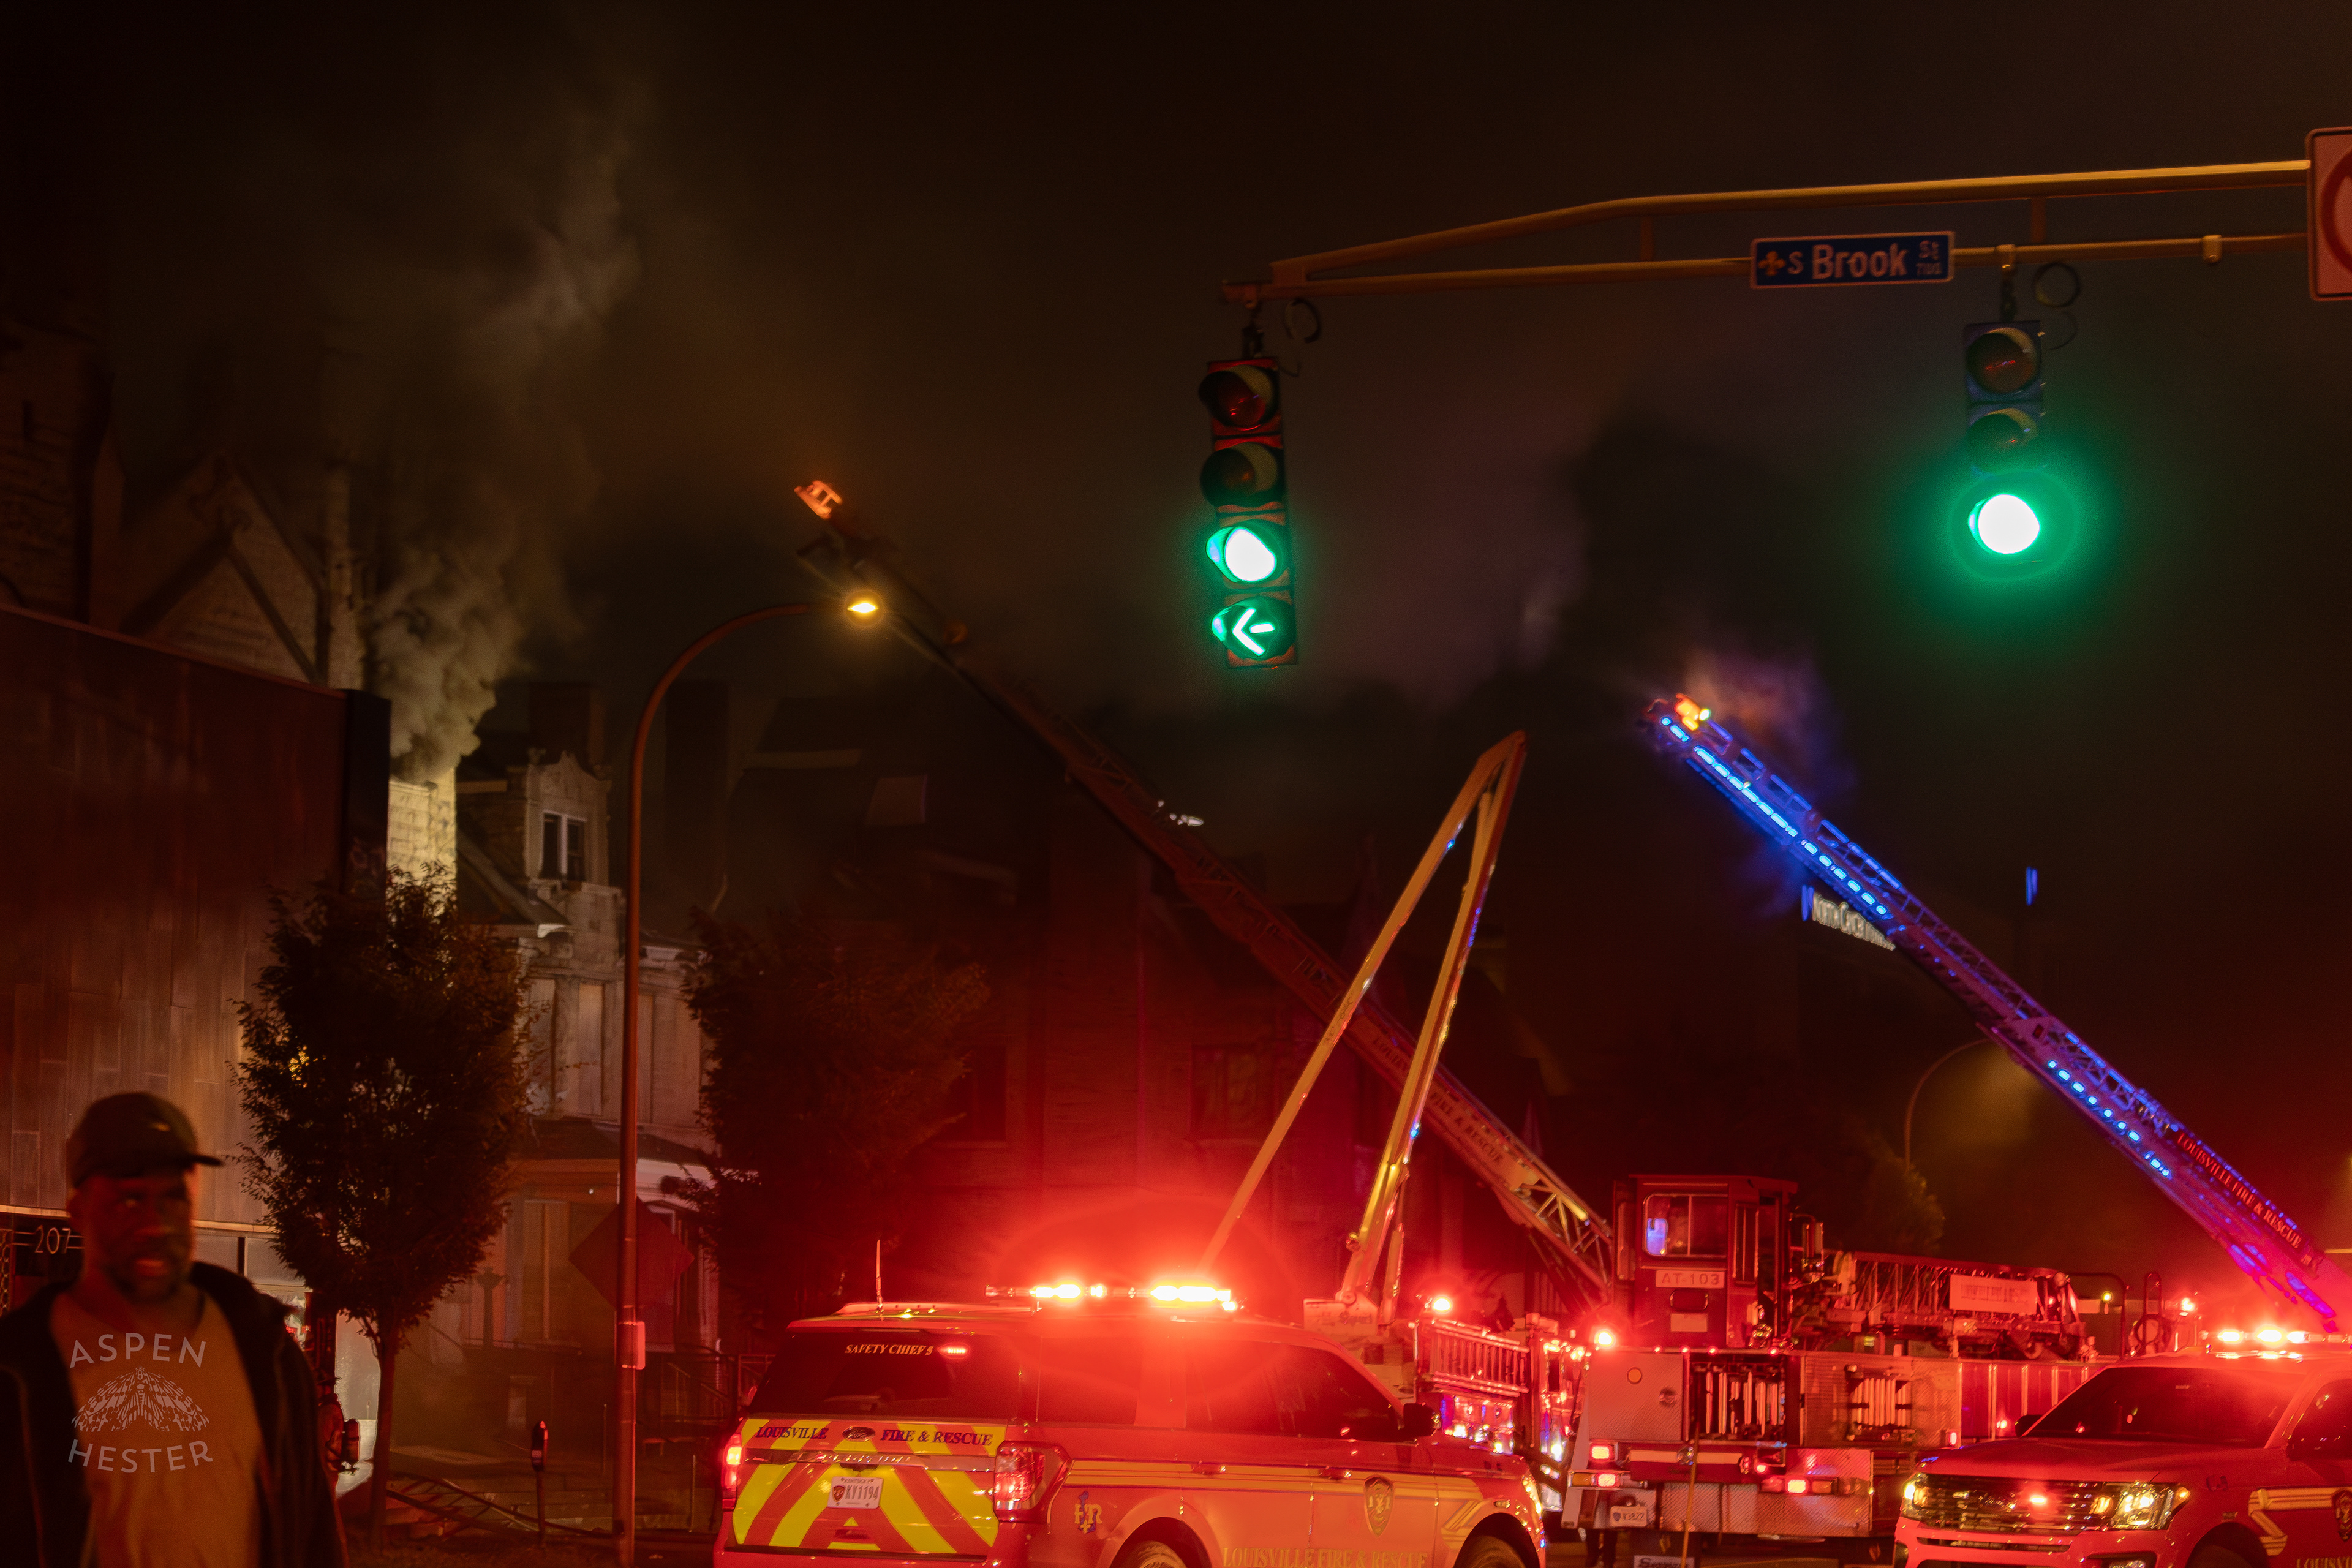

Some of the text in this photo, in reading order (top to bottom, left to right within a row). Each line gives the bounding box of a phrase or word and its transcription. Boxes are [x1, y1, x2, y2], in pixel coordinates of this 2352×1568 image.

[1787, 251, 1803, 274] S
[1812, 244, 1909, 279] Brook
[2177, 1132, 2234, 1188] LOUISVILLE
[2263, 1209, 2302, 1249] RESCUE
[35, 1225, 71, 1254] 207
[1661, 1273, 1721, 1286] AT-103
[844, 1344, 888, 1354] SAFETY
[888, 1344, 927, 1355] CHIEF
[755, 1426, 829, 1439] LOUISVILLE
[880, 1428, 916, 1442] FIRE
[918, 1431, 928, 1442] &
[933, 1431, 994, 1447] RESCUE
[1223, 1547, 1314, 1568] LOUISVILLE
[1317, 1548, 1353, 1568] FIRE
